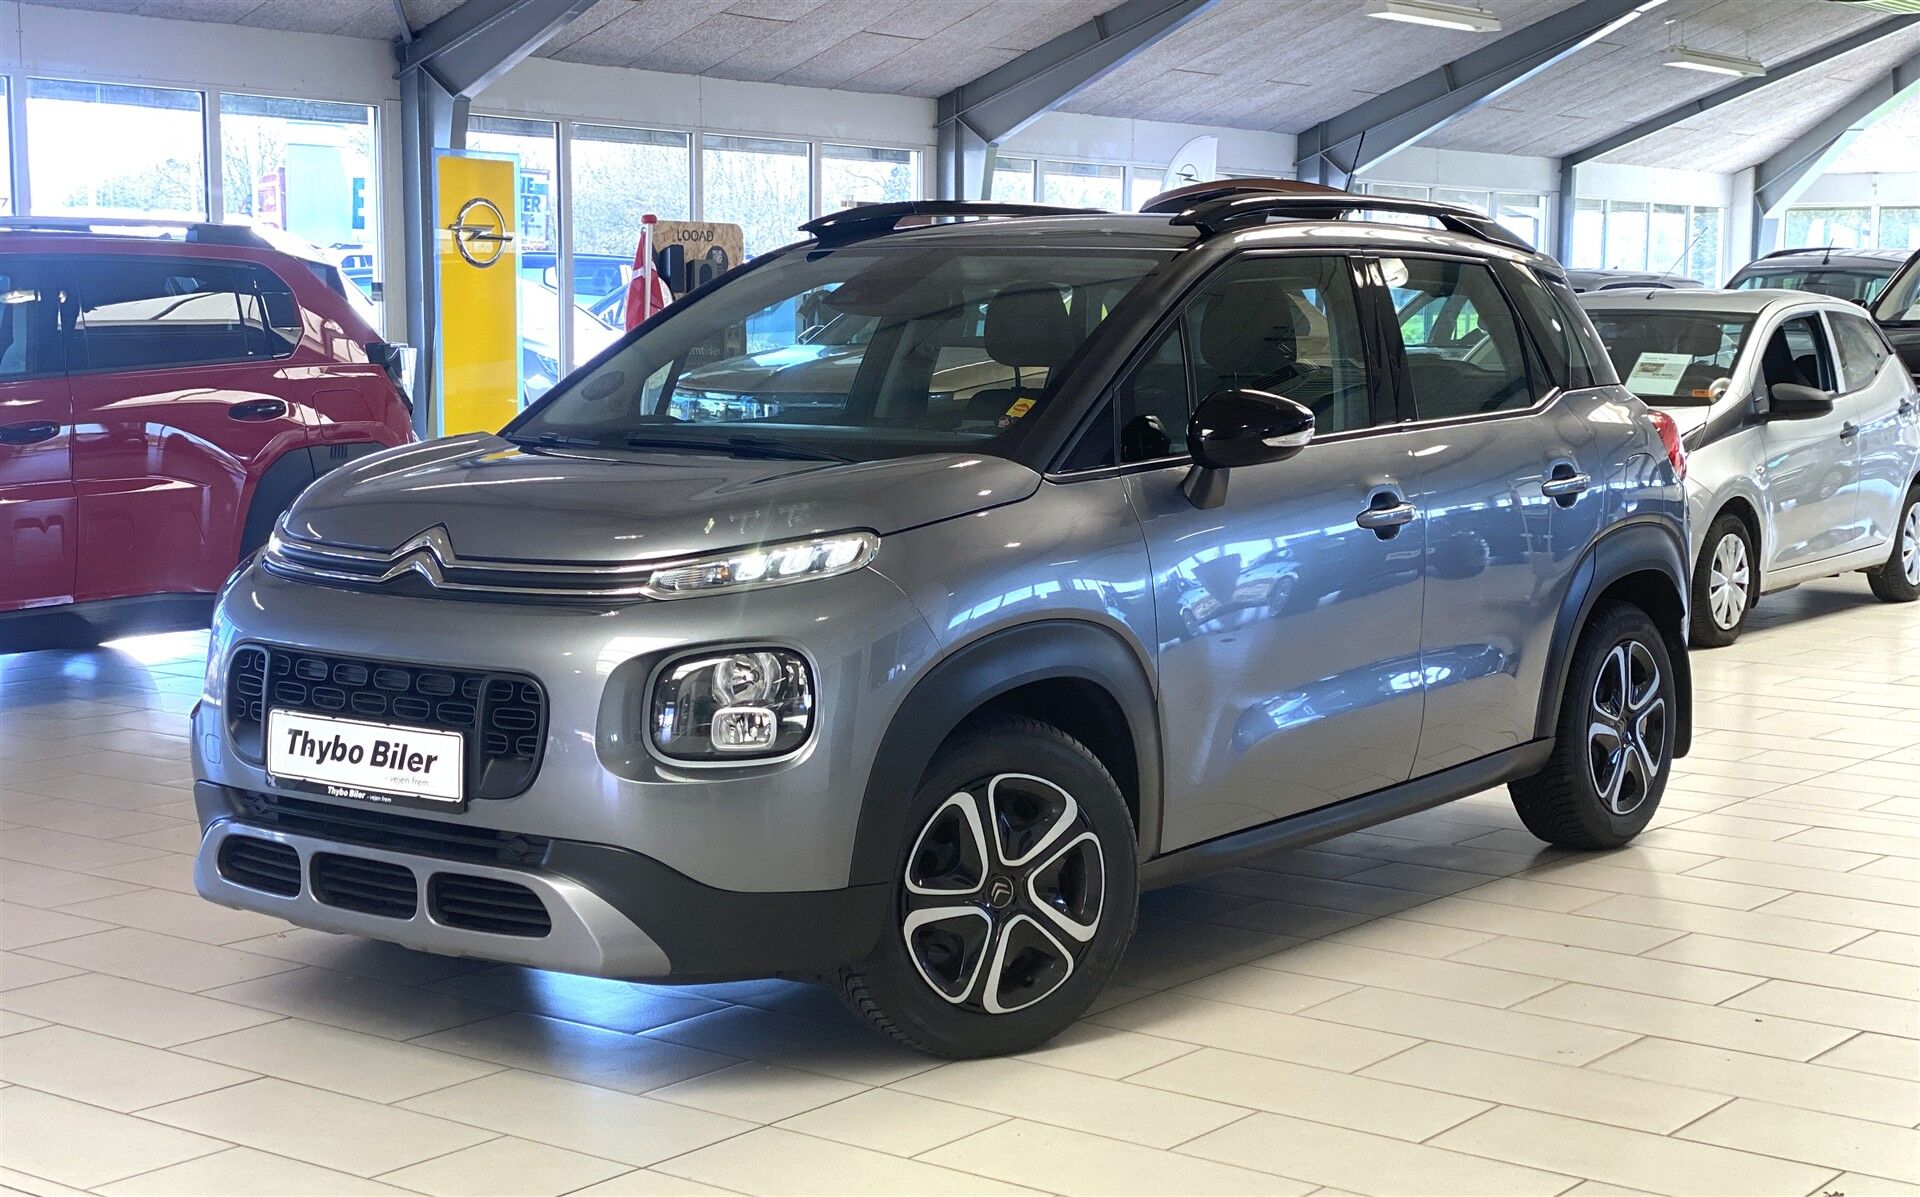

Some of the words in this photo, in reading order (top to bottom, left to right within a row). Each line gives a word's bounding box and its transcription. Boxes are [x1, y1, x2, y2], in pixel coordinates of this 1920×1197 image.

[677, 229, 714, 242] LOOAD
[287, 728, 364, 764] Thybo
[370, 740, 438, 773] Biler
[390, 776, 410, 785] vejen
[328, 786, 348, 797] Thybo
[349, 789, 366, 799] Biler
